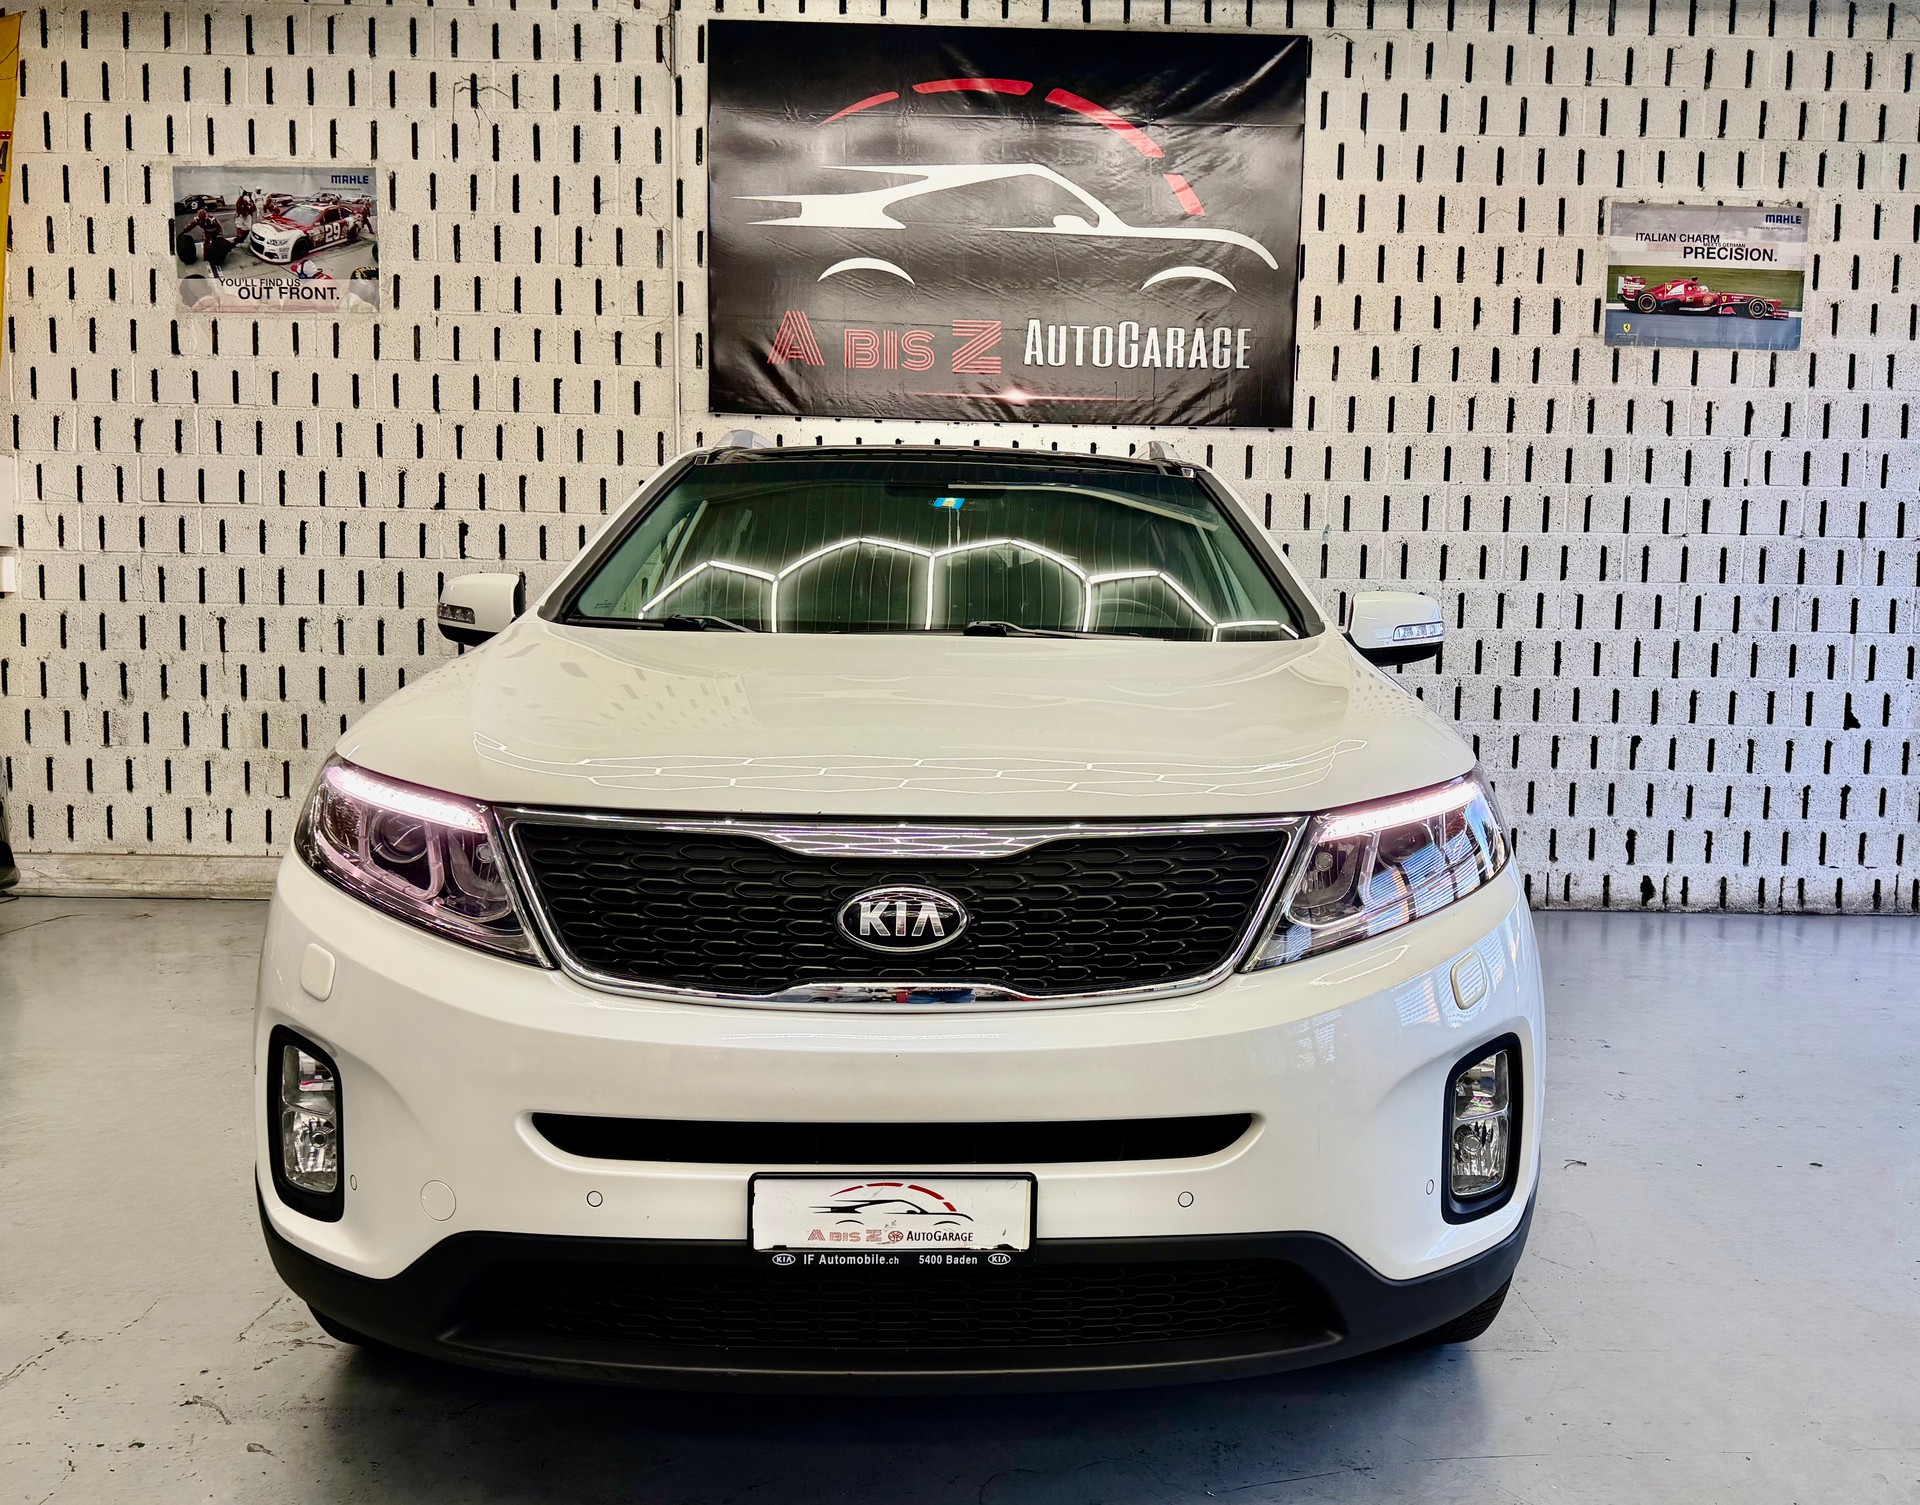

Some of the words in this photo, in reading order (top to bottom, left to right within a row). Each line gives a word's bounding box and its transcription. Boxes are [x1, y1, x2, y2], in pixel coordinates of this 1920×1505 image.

[331, 175, 369, 184] MAHLE
[1765, 214, 1802, 224] MAHLE
[325, 223, 341, 243] 29
[1636, 232, 1677, 242] ITALIAN
[1679, 234, 1720, 243] CHARM
[1683, 246, 1778, 262] PRECISION.
[219, 278, 257, 287] YOU'LL
[259, 279, 283, 287] FIND
[286, 279, 301, 287] US
[238, 286, 273, 300] OUT
[279, 286, 340, 300] FRONT.
[767, 310, 825, 366] A
[844, 329, 936, 370] BIS
[952, 319, 1002, 374] Z
[859, 901, 945, 937] KIA
[807, 1229, 826, 1241] A
[865, 1229, 882, 1242] Z
[803, 1254, 815, 1265] IF
[819, 1254, 900, 1265] Automobile.ch
[918, 1255, 943, 1265] 5400
[946, 1255, 978, 1265] Baden
